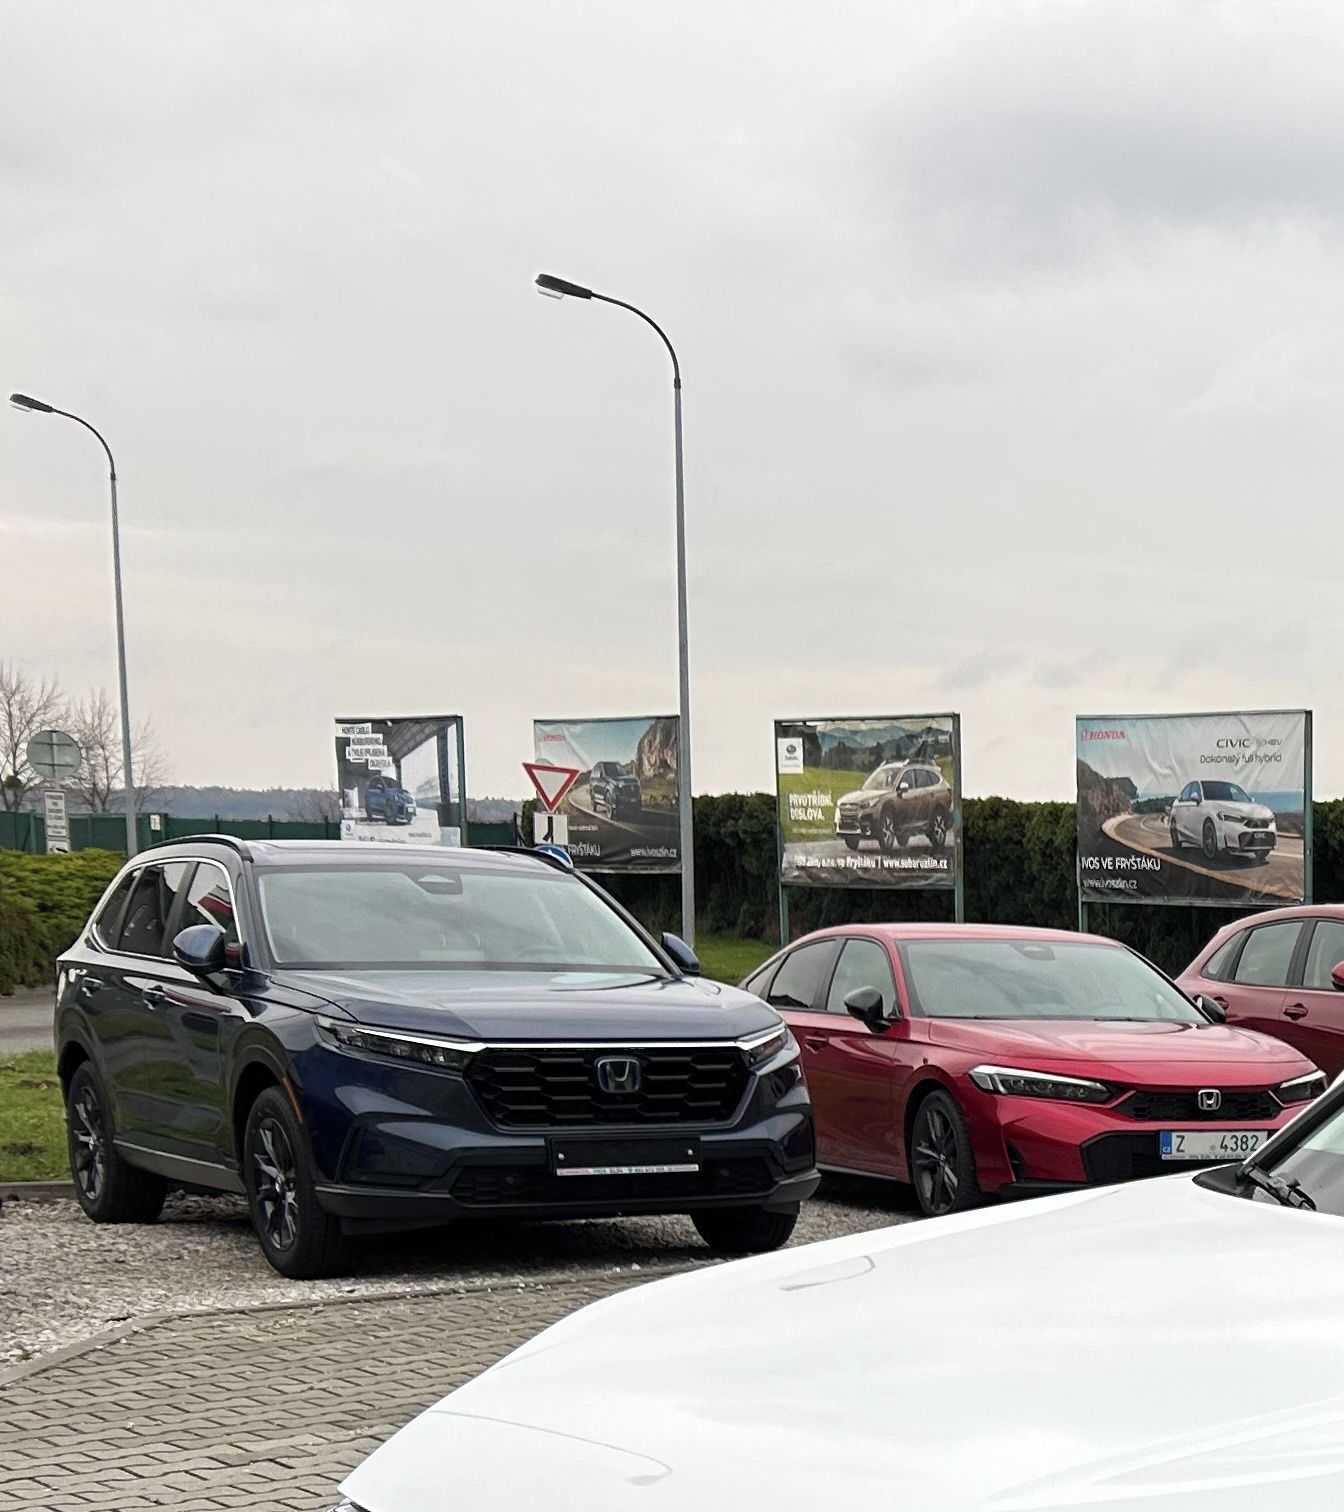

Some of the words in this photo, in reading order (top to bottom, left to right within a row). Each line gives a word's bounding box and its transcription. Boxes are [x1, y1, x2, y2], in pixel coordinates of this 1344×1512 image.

[1089, 730, 1125, 741] HONDA
[1216, 738, 1250, 748] CIVIC
[1101, 858, 1113, 869] VE
[1116, 855, 1161, 871] FRYŠTÁKU
[1175, 1135, 1185, 1152] Z
[1219, 1134, 1259, 1153] 4382
